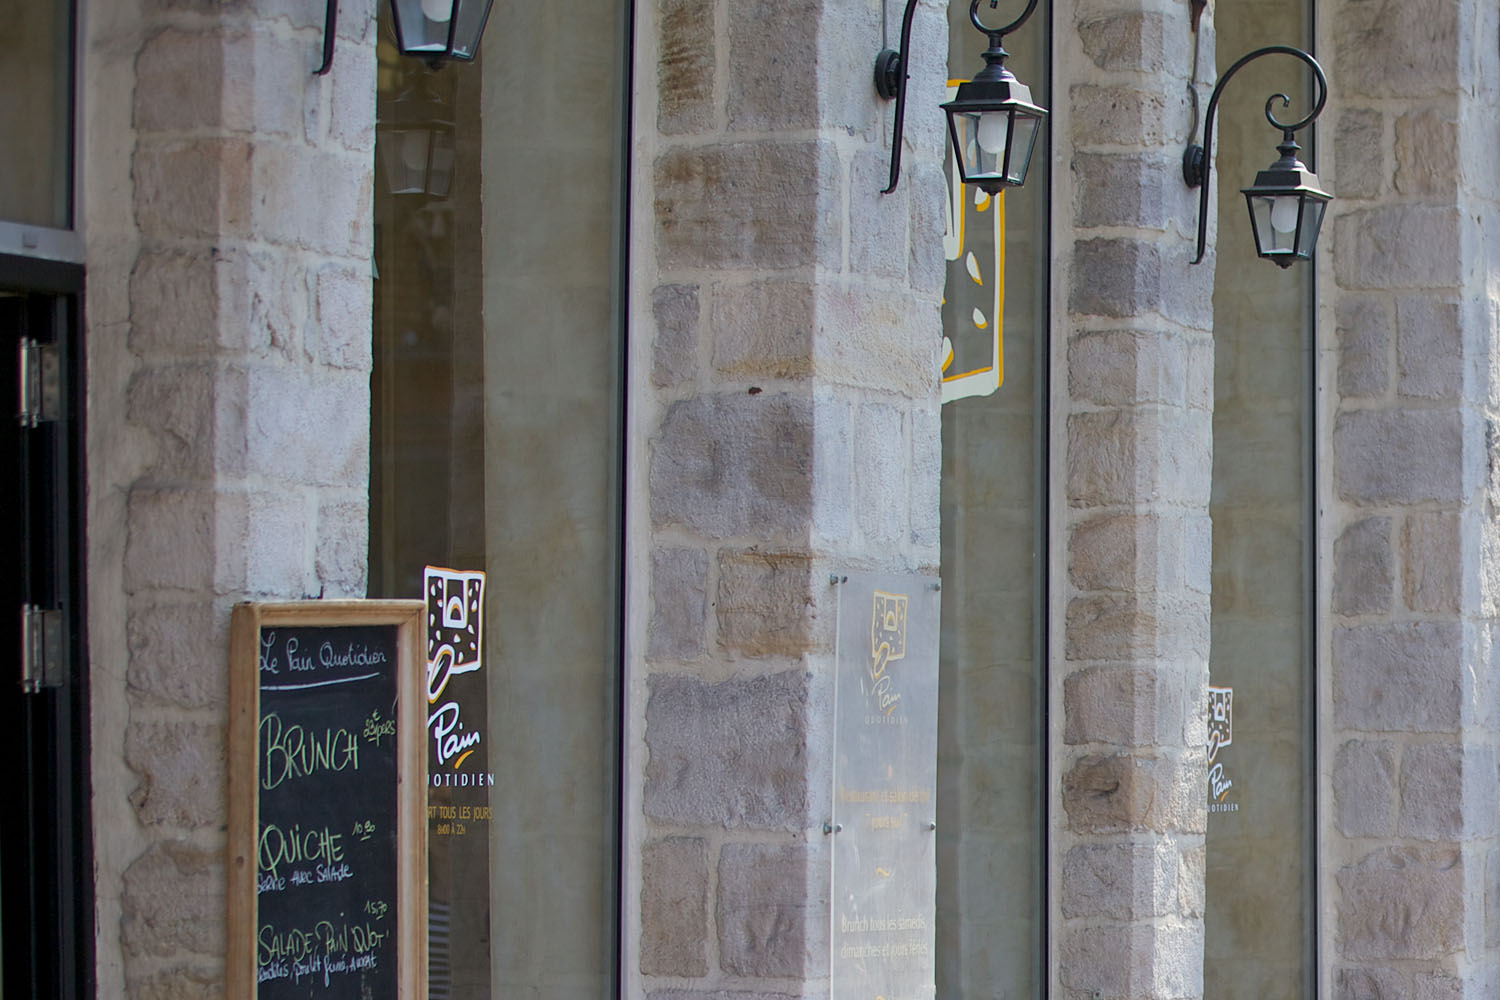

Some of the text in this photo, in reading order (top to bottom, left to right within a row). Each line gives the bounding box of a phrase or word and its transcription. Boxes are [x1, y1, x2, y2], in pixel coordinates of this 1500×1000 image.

[259, 632, 387, 674] Le Pain Quotidien
[871, 676, 901, 710] Pain
[259, 713, 358, 790] BRUNCH
[427, 702, 481, 765] Pain
[1208, 763, 1232, 800] Pain
[259, 925, 313, 966] SALADE
